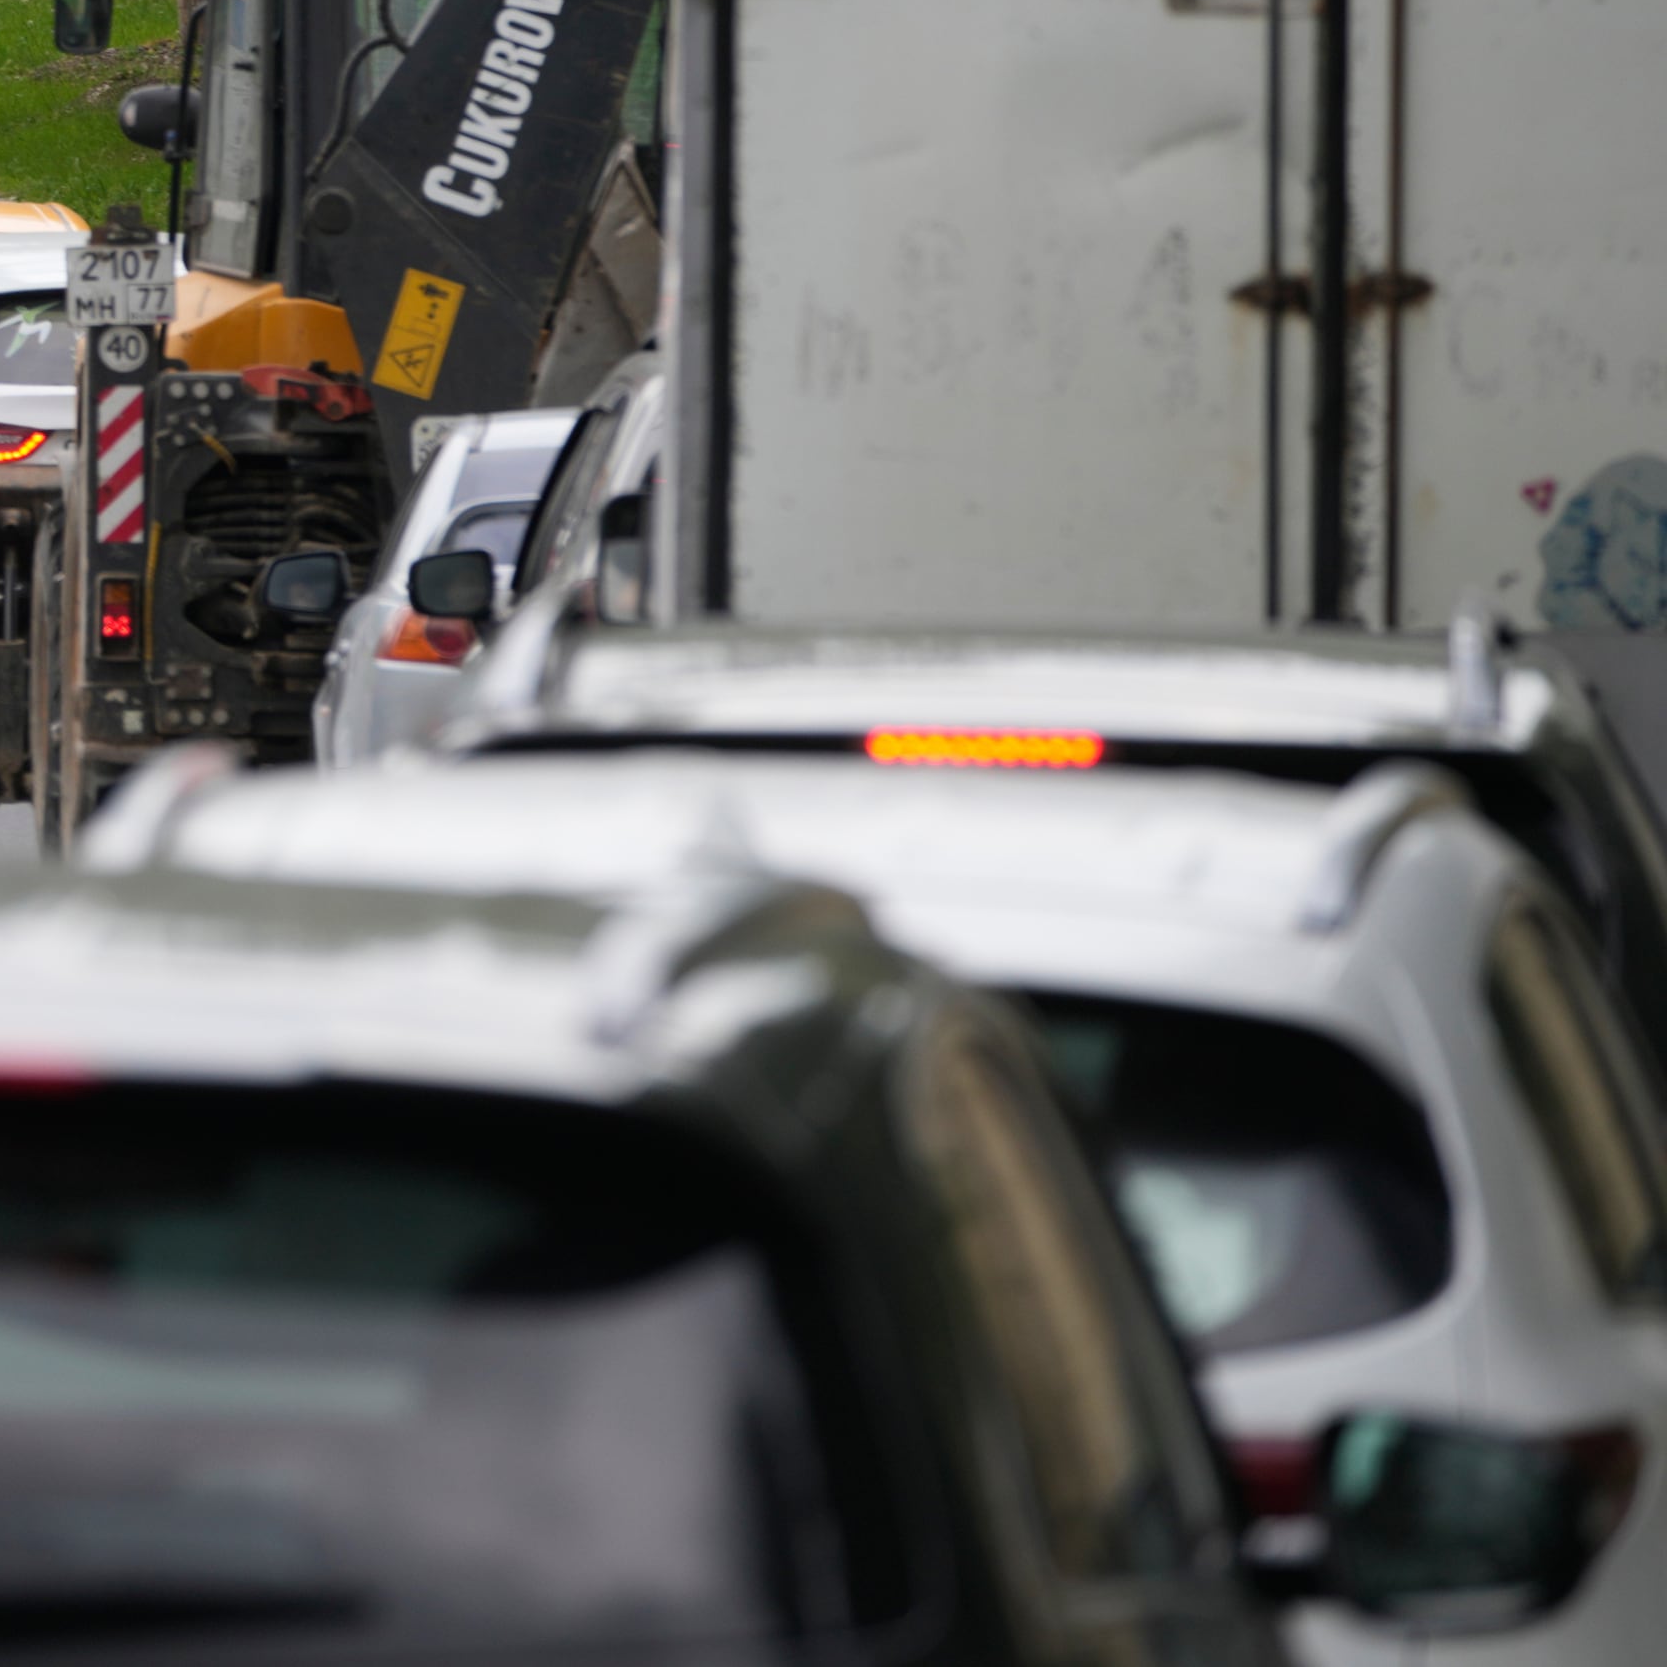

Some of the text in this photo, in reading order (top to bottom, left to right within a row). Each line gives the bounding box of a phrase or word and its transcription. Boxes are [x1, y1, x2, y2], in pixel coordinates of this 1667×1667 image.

[80, 249, 160, 282] 2107
[75, 286, 168, 320] МН 77
[106, 335, 142, 361] 40
